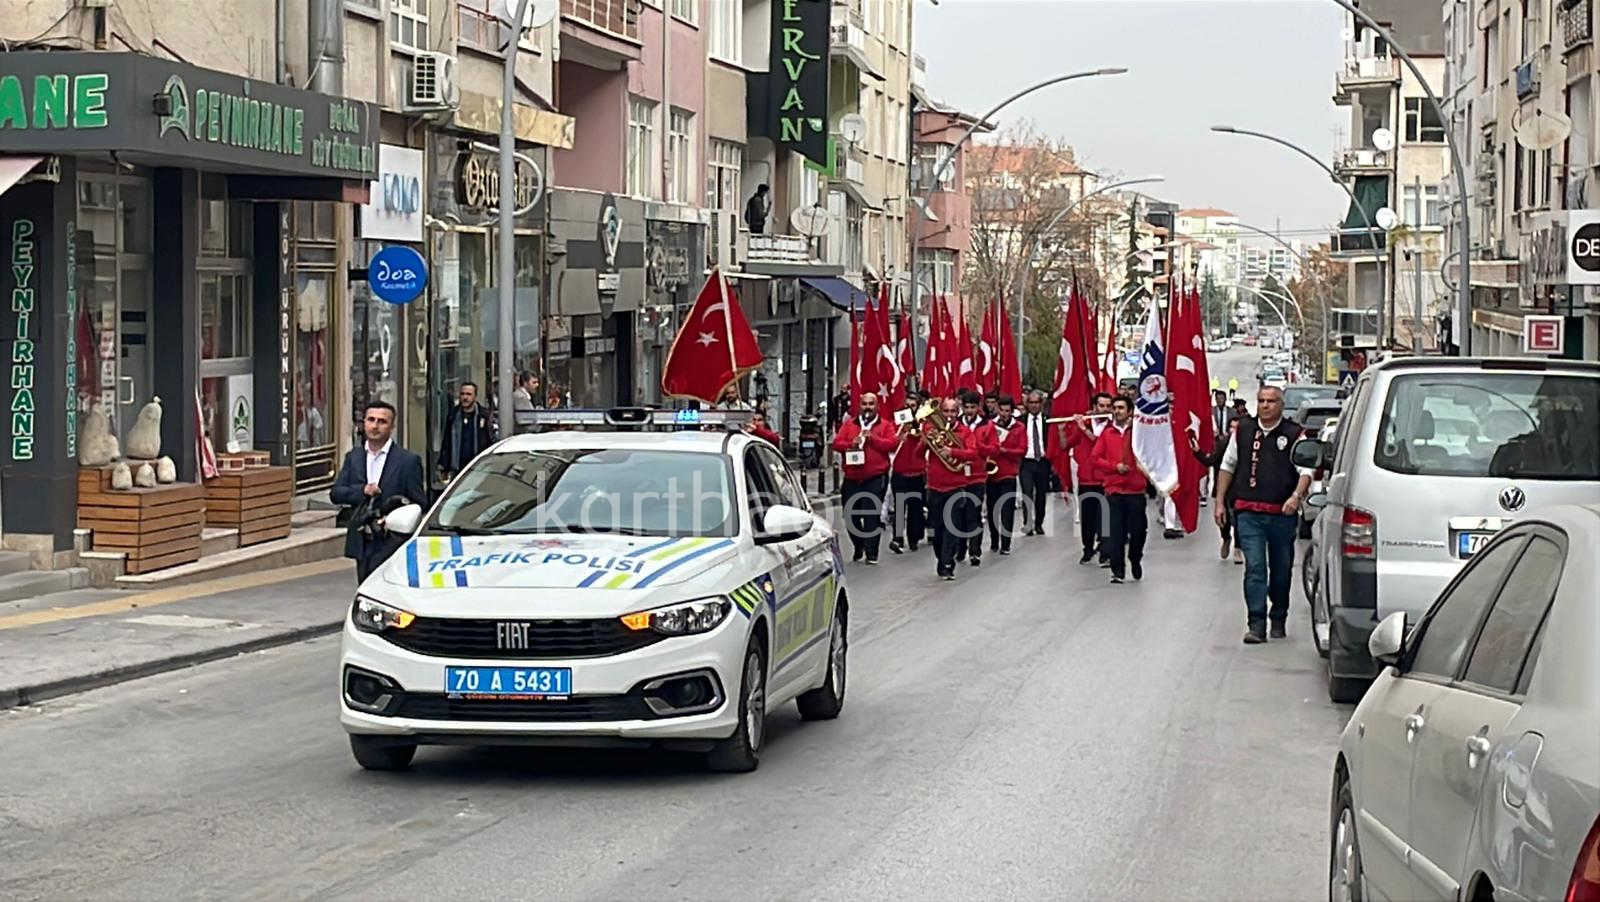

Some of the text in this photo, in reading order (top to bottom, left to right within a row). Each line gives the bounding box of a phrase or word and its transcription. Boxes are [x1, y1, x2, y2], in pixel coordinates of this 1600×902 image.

[0, 73, 109, 130] ANE
[194, 88, 305, 156] PEYNİRHANE
[11, 219, 35, 460] PEYNİRHANE
[1531, 323, 1557, 348] E
[497, 622, 531, 649] FIAT
[455, 670, 562, 692] 70 A 5431
